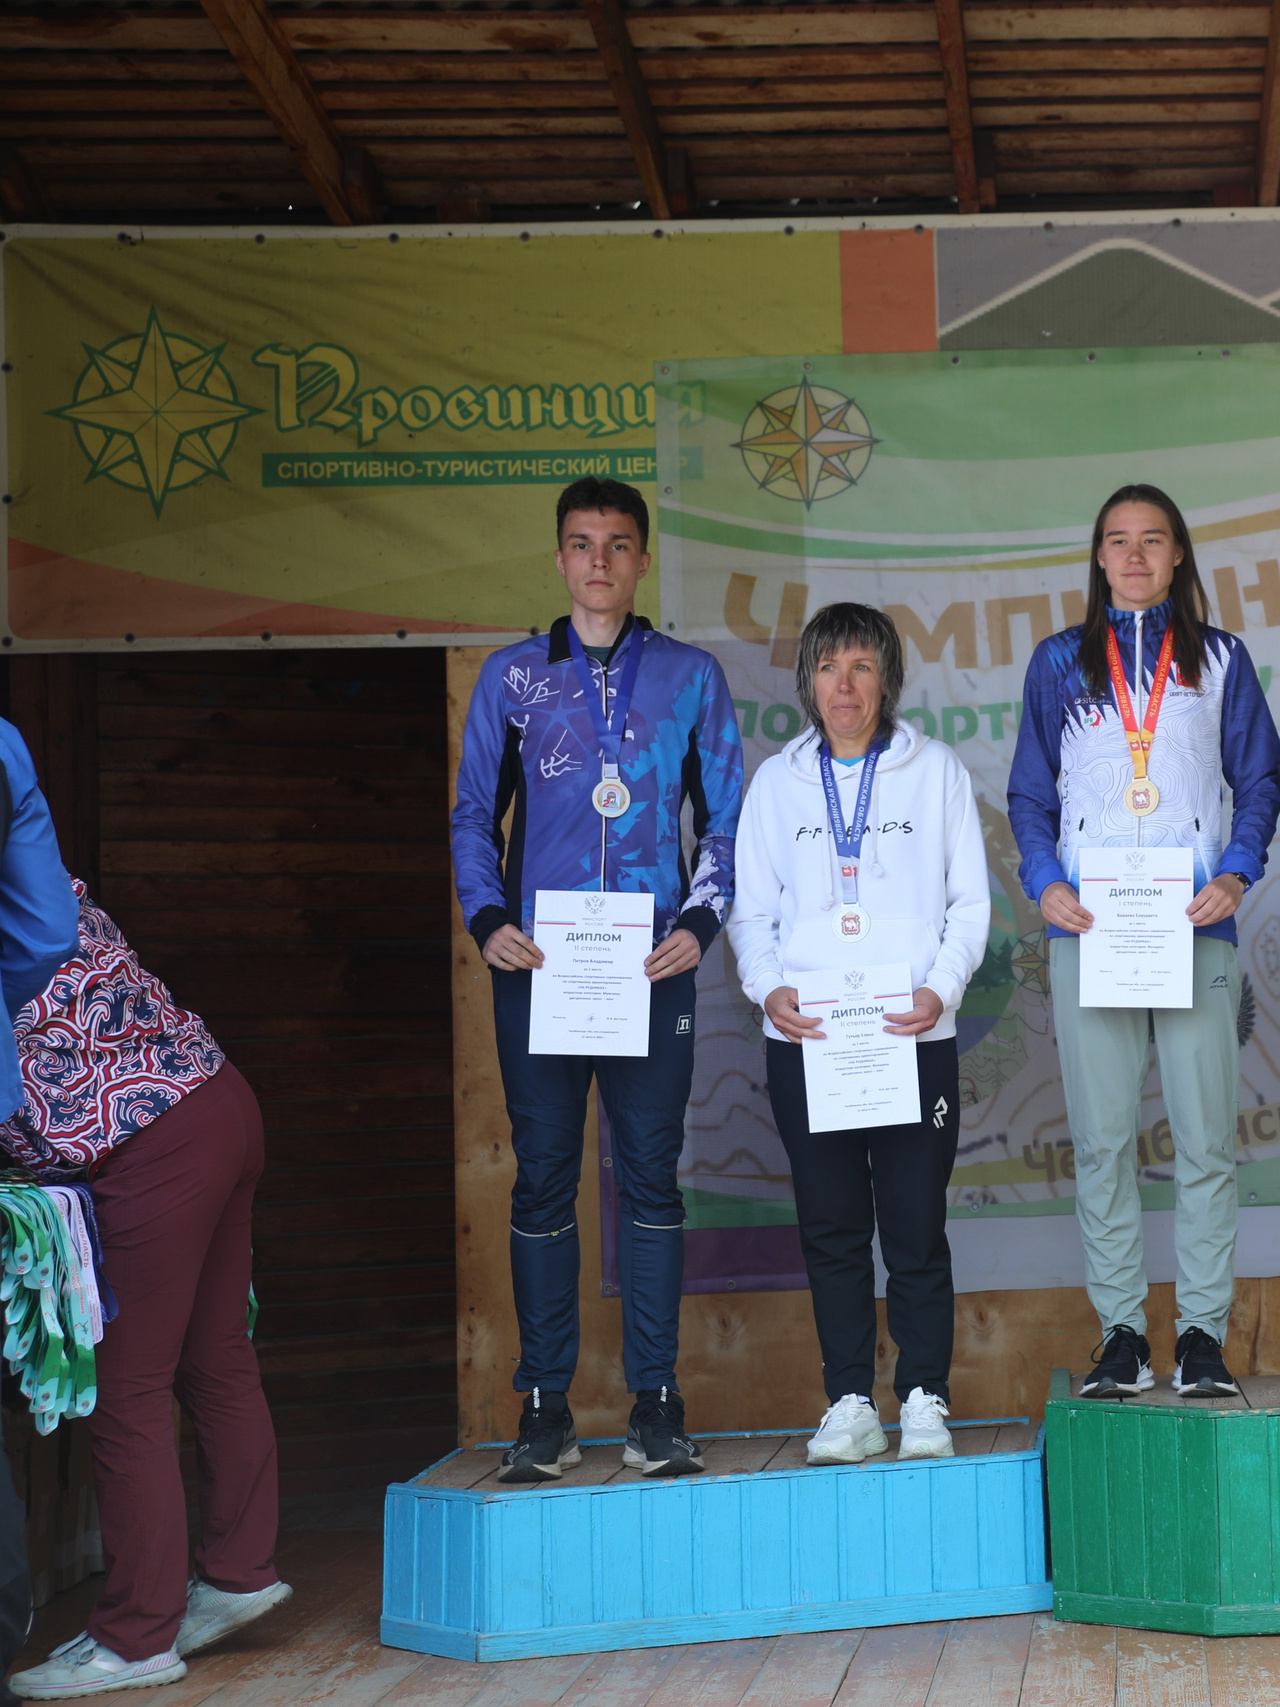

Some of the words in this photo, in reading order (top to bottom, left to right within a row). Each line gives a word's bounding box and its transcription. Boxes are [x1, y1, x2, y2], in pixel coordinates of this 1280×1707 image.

[277, 453, 611, 479] СПОРТИВНО-ТУРИСТИЧЕСКИЙ
[1113, 665, 1131, 719] ЧЕЛЯБИНСКАЯ
[1149, 683, 1163, 717] ОБЛАСТЬ
[821, 755, 833, 788] ОБЛАСТЬ
[859, 751, 878, 806] ЧЕЛЯБИНСКАЯ
[826, 788, 844, 844] ЧЕЛЯБИНСКАЯ
[852, 805, 866, 843] ОБЛАСТЬ
[1109, 888, 1163, 898] ДИПЛОМ
[565, 932, 622, 943] ДИПЛОМ
[831, 1005, 885, 1020] ДИПЛОМ
